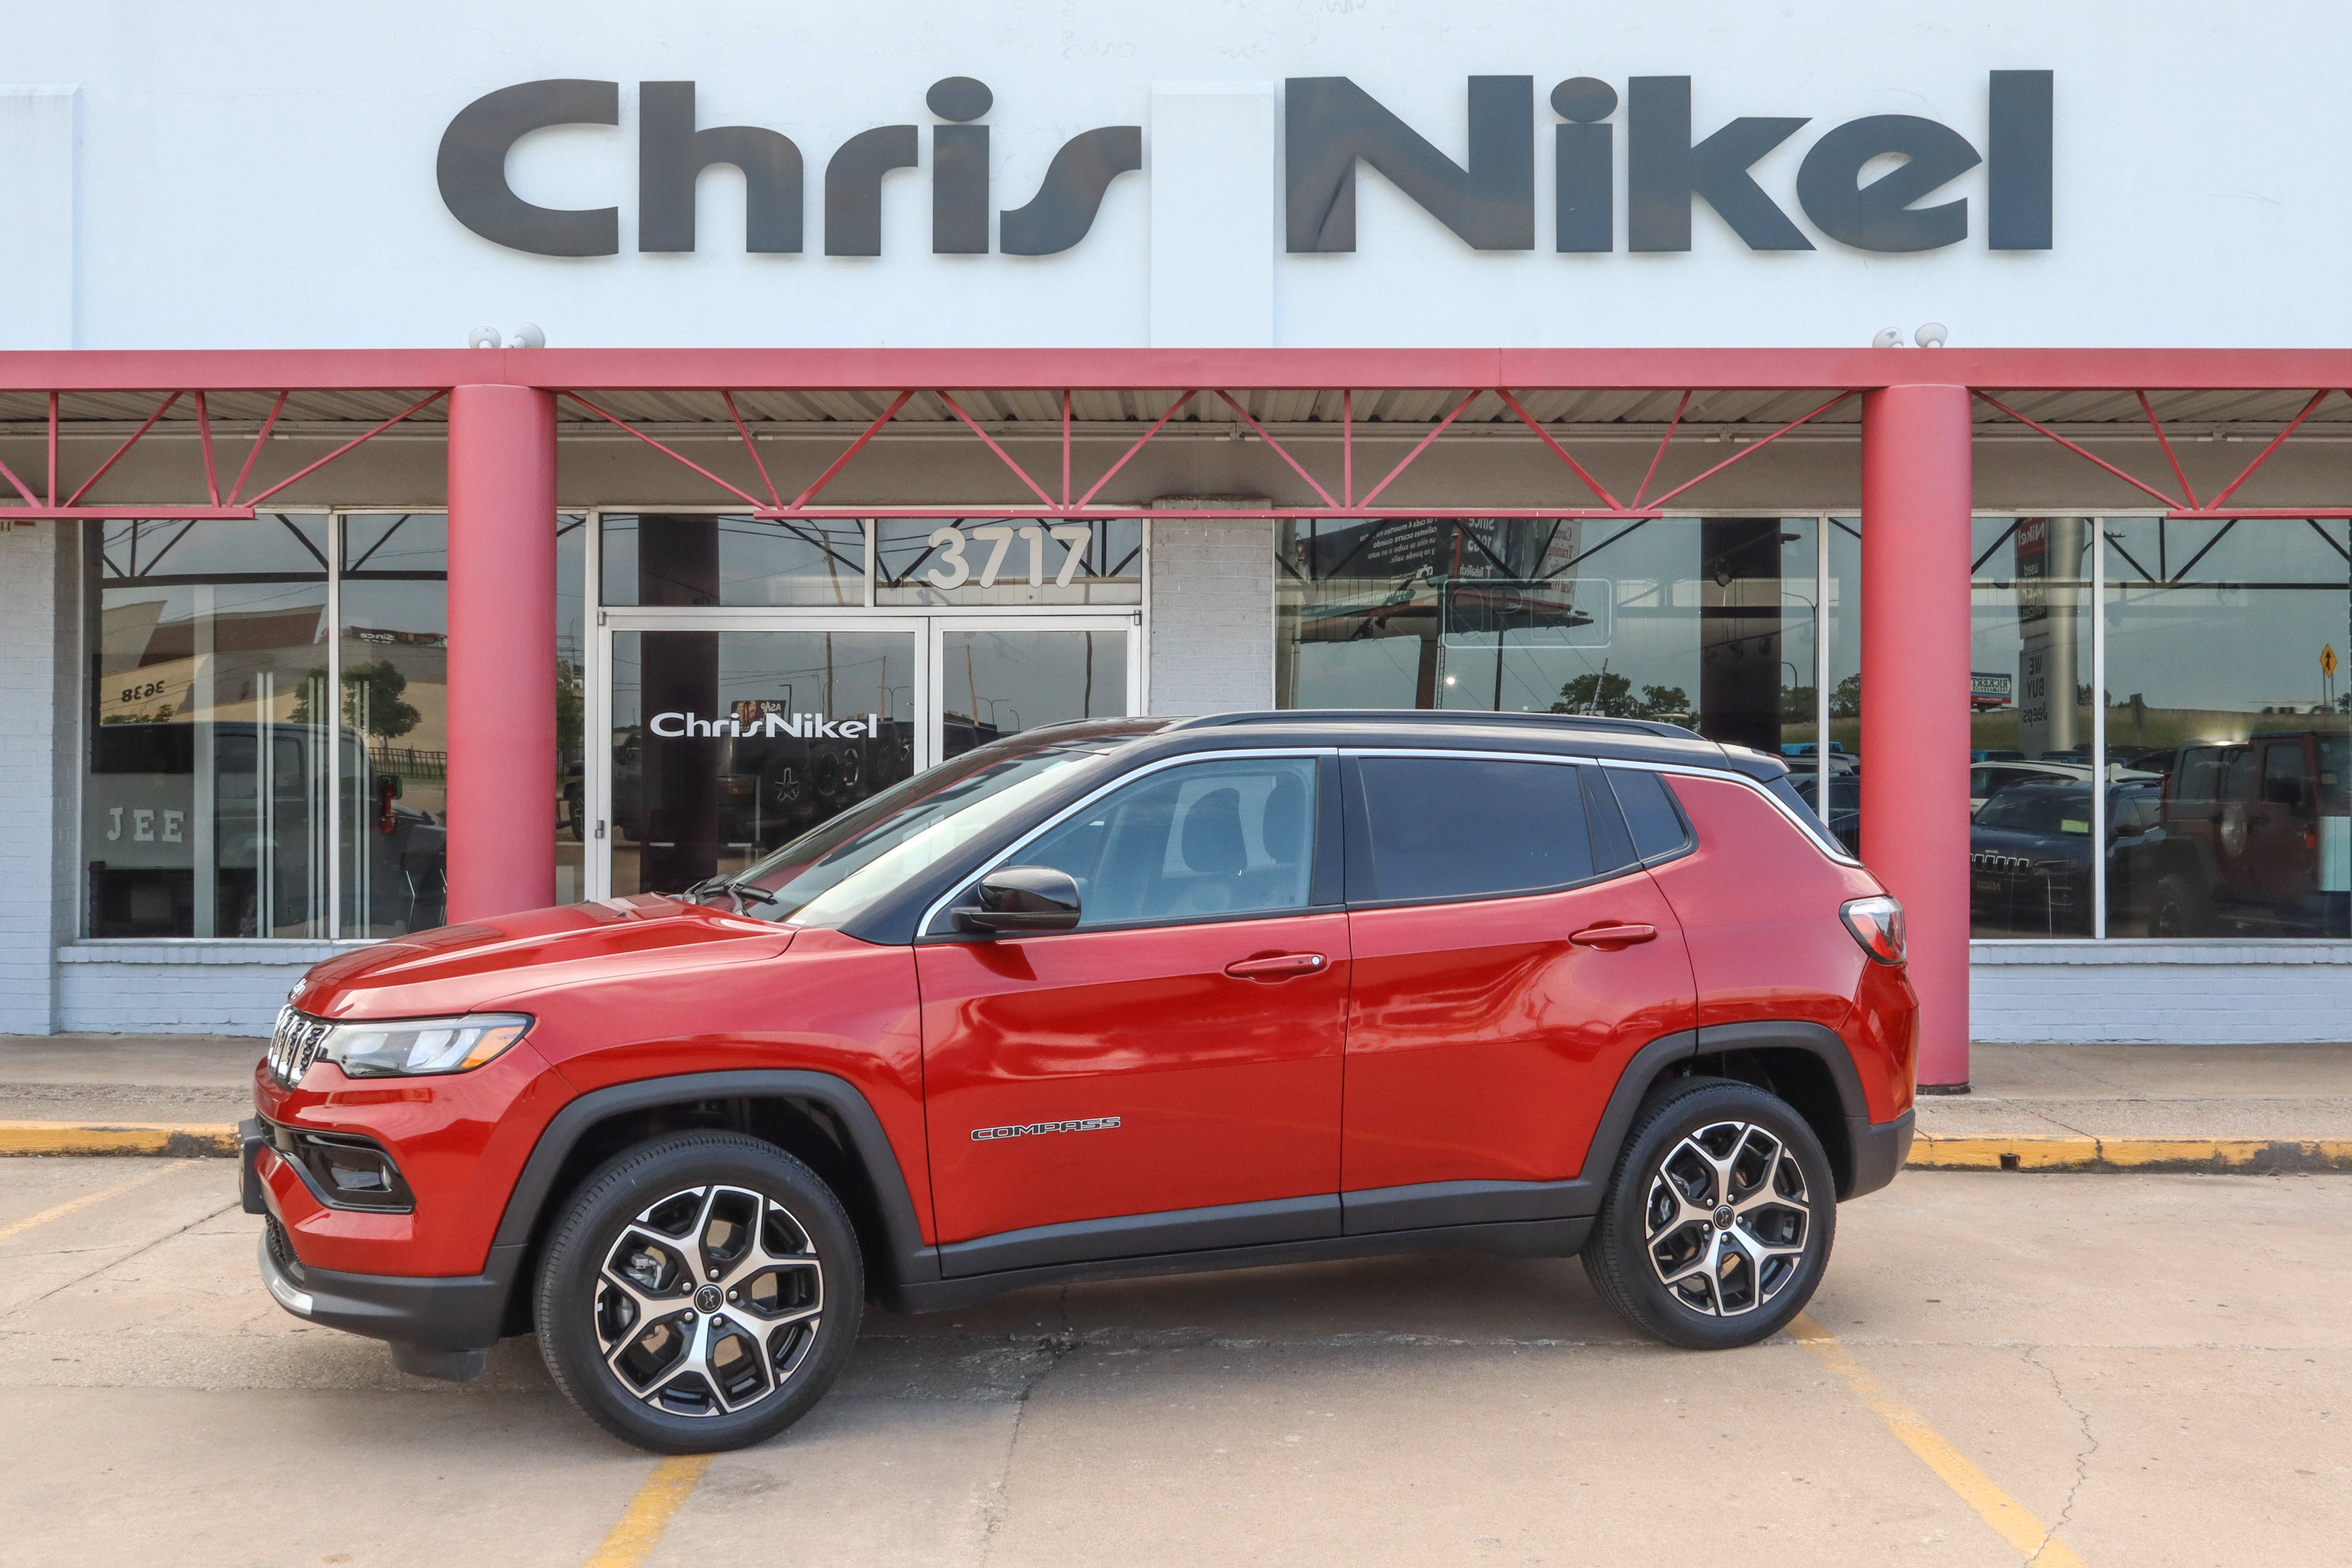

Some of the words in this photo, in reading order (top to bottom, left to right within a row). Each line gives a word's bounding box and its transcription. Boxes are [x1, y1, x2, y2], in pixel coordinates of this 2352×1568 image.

[437, 76, 1142, 256] Chris
[1285, 69, 2054, 253] Nikel
[927, 526, 1092, 590] 3717
[971, 1116, 1121, 1141] COMPASS
